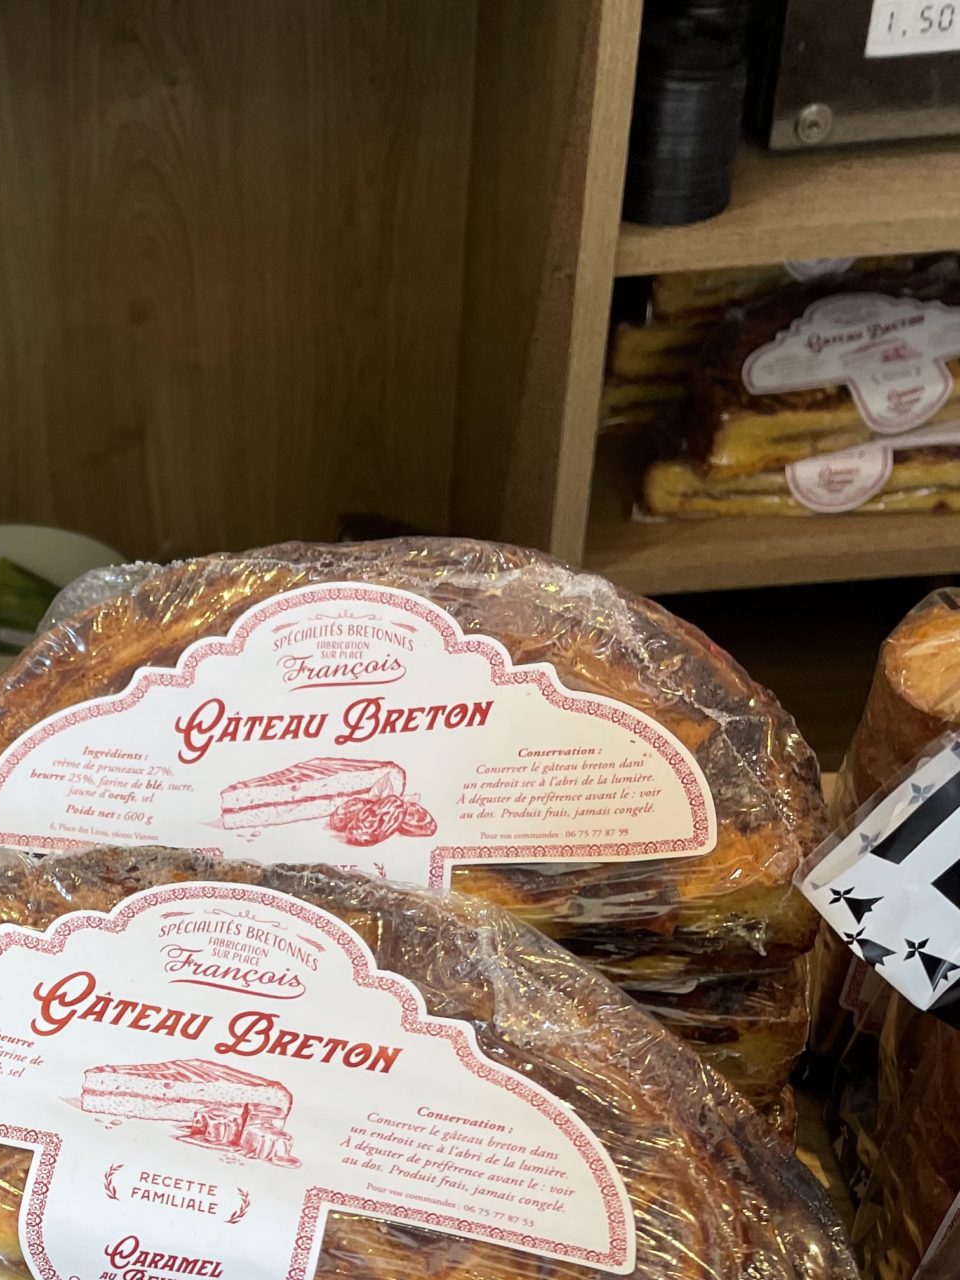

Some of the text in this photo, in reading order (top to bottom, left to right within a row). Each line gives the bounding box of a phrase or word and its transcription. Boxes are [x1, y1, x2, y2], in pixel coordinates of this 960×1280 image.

[273, 622, 414, 651] SPÉCIALITÉS BRETONNES
[316, 641, 369, 649] FABRICATION
[321, 651, 363, 659] SUR PLACE
[277, 654, 407, 692] François
[175, 697, 494, 764] GÂTEAU BRETON
[476, 759, 644, 775] Conserver le gâteau breton dans
[158, 919, 318, 972] SPÉCIALITÉS BRETONNES
[209, 936, 268, 958] FABRICATION
[211, 948, 261, 966] SUR PLACE
[160, 944, 306, 1000] François
[30, 971, 403, 1074] GÂTEAU BRETON
[8, 1067, 25, 1078] sel
[30, 1056, 44, 1067] de
[140, 1171, 218, 1196] RECETTE
[131, 1187, 218, 1214] FAMILIALE
[104, 1235, 223, 1278] CARAMEL
[100, 1271, 117, 1280] AU
